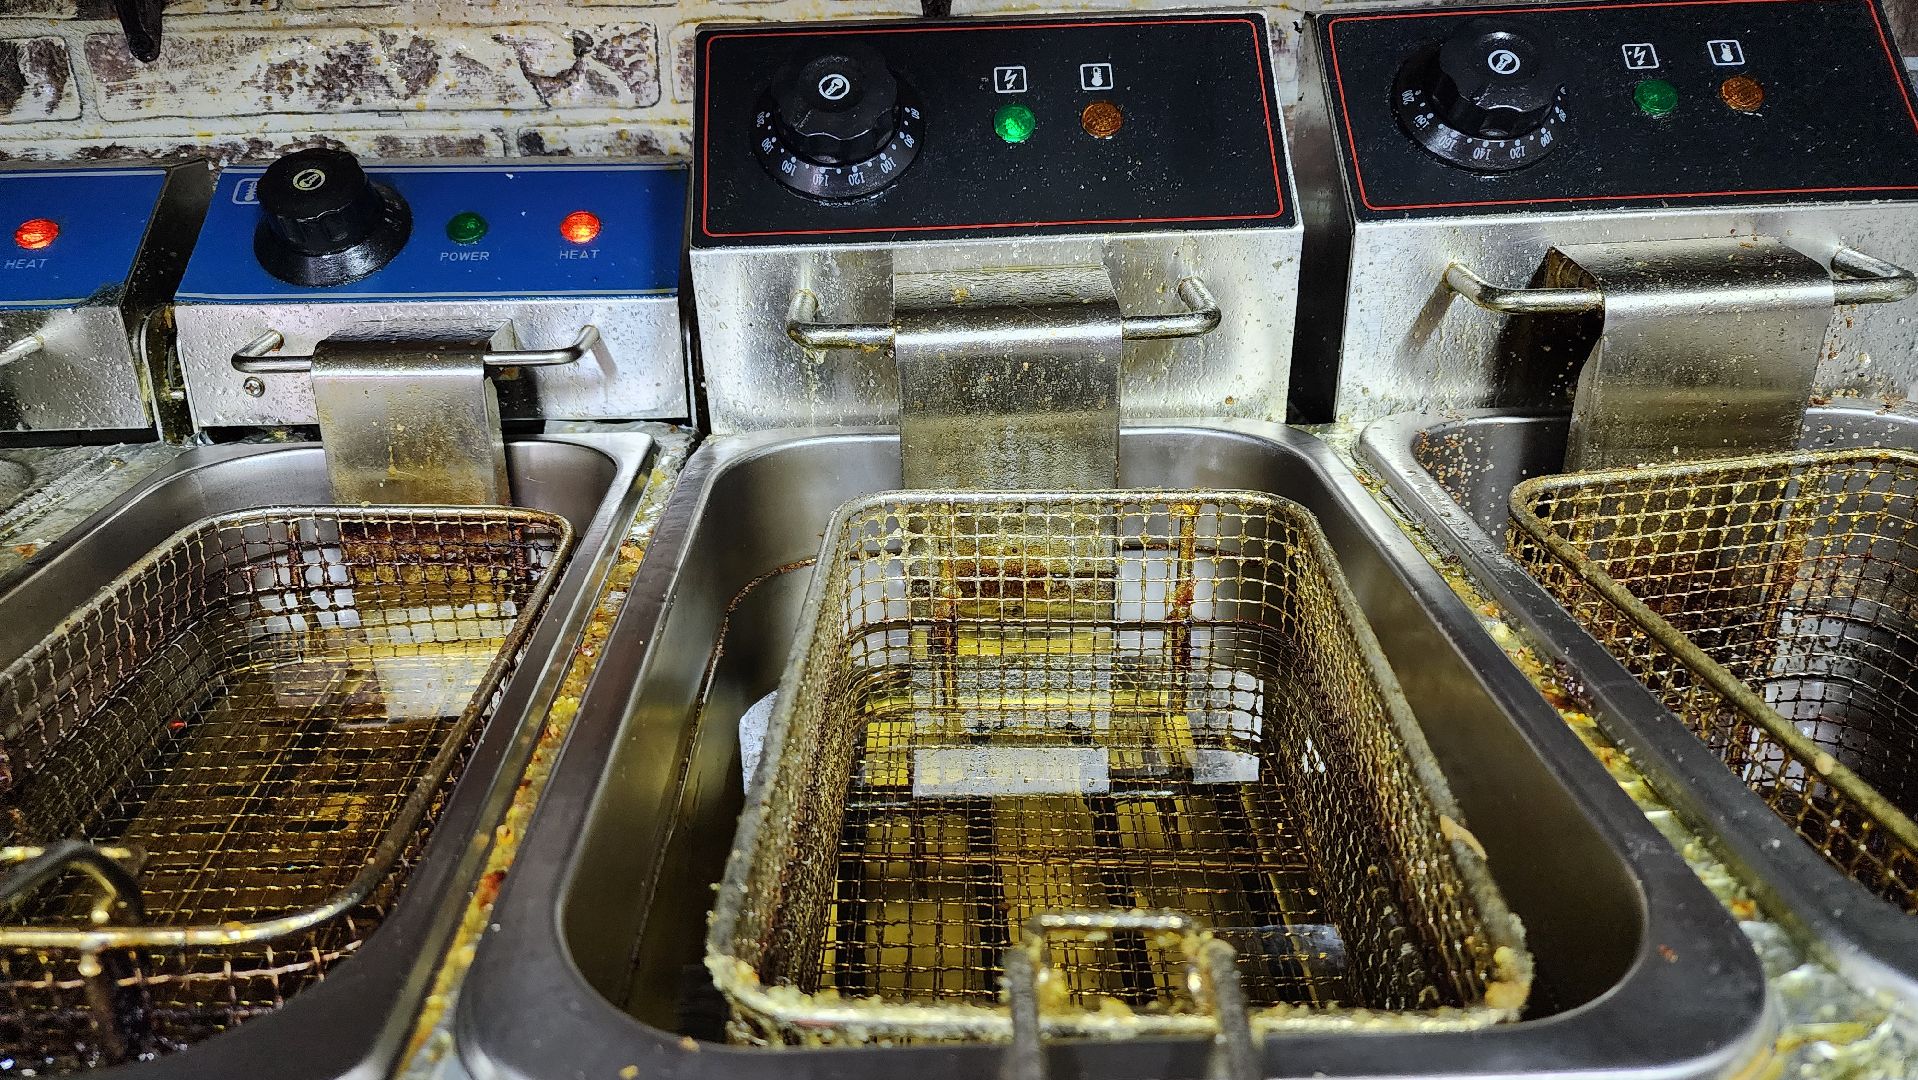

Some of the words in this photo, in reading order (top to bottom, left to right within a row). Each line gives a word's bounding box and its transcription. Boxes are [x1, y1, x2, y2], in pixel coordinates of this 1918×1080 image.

[761, 137, 774, 155] 180
[904, 134, 915, 148] 80
[1439, 135, 1457, 152] 160
[1541, 130, 1554, 148] 100
[1473, 147, 1492, 161] 140
[1509, 145, 1526, 160] 120
[781, 160, 797, 177] 160
[880, 156, 897, 174] 100
[812, 173, 830, 188] 140
[848, 171, 866, 186] 120
[439, 251, 490, 262] POWER
[559, 249, 601, 260] HEAT
[4, 258, 49, 270] HEAT
